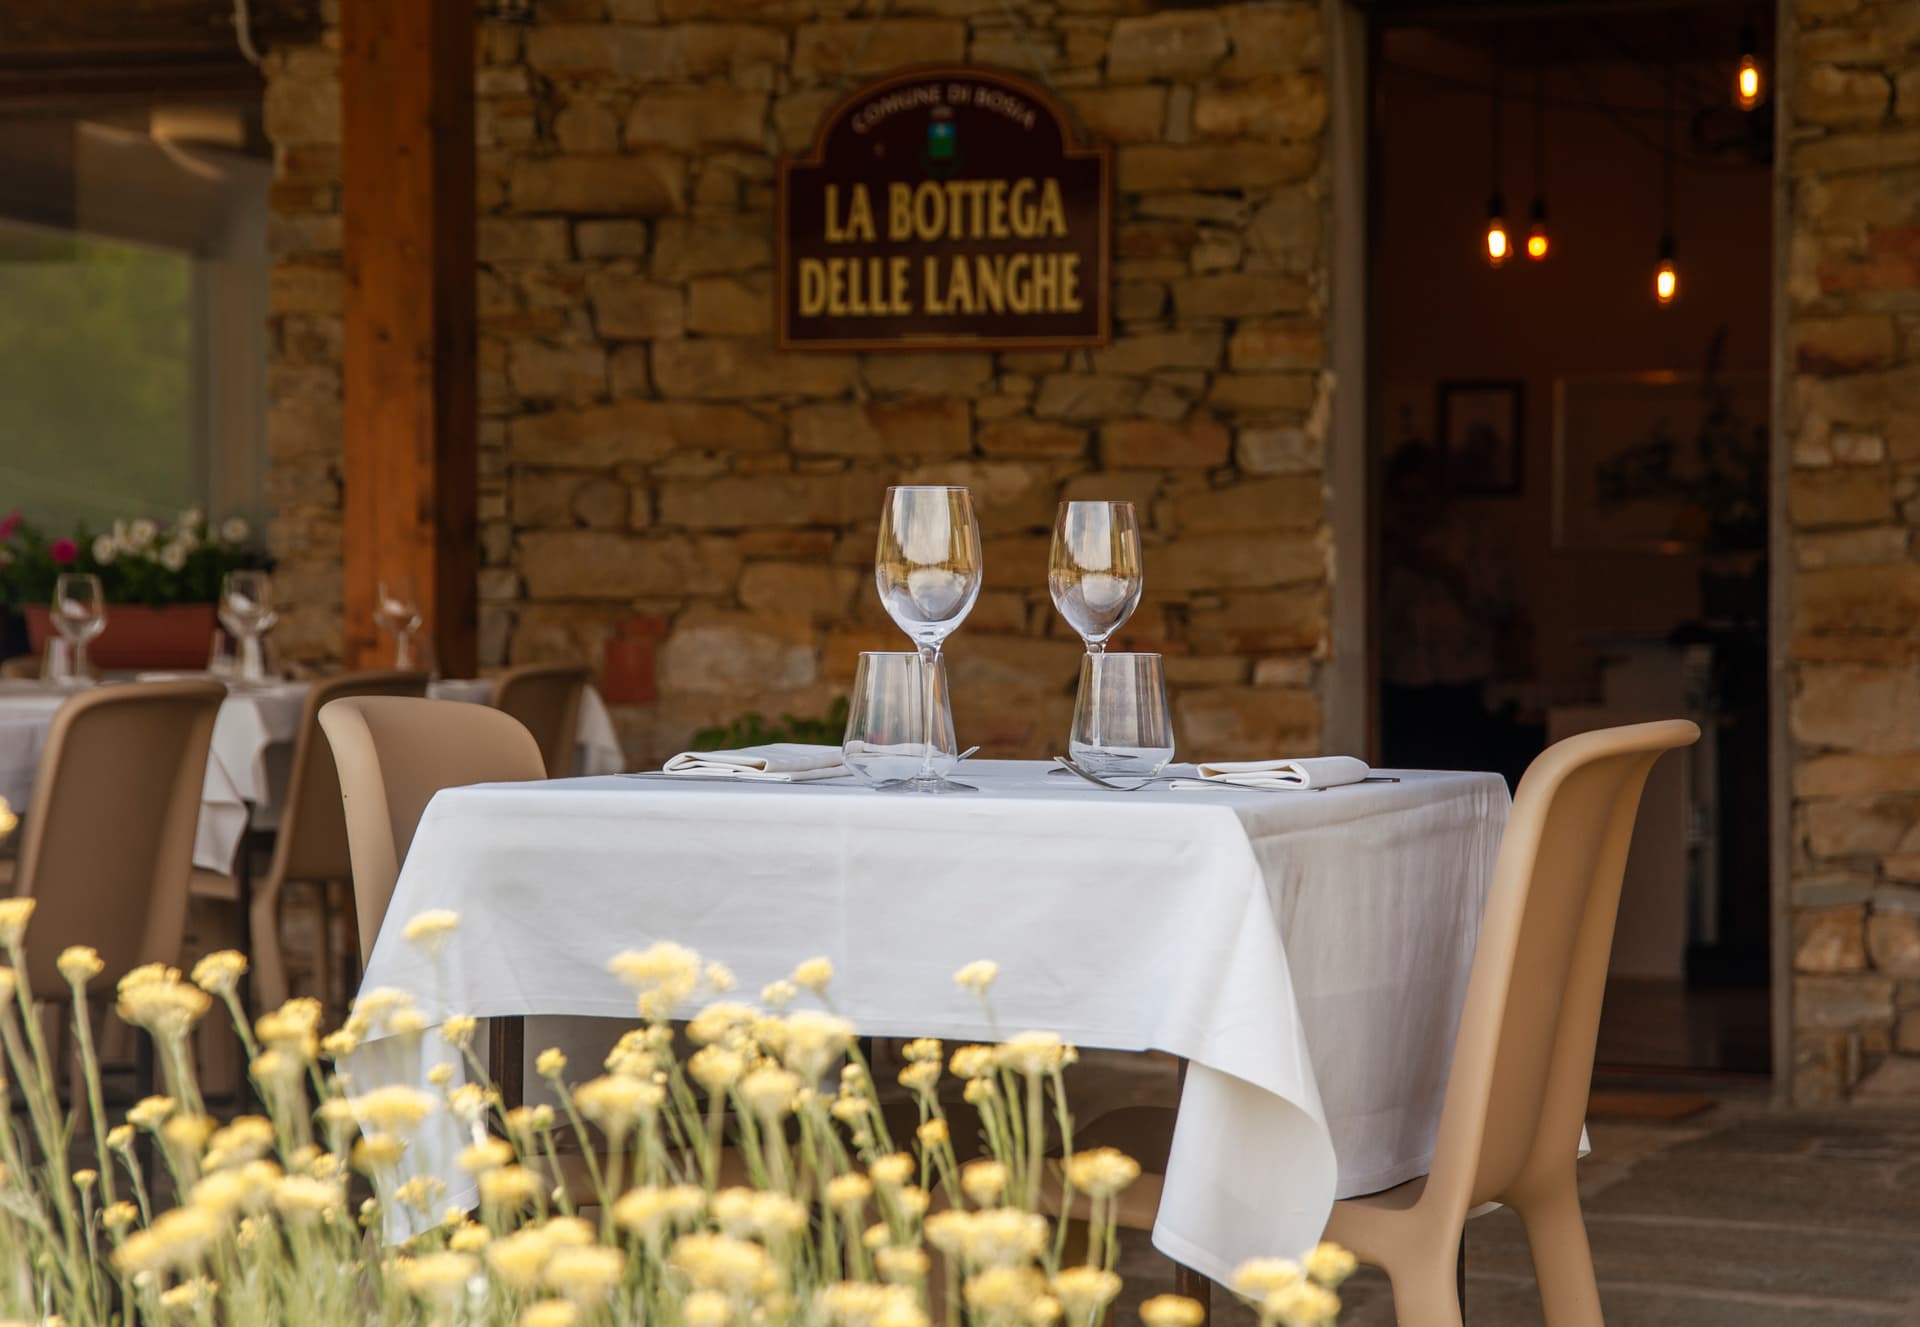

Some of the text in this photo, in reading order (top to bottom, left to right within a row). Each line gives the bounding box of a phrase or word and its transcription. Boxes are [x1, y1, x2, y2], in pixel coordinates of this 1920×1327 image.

[852, 84, 940, 134] COMUNE
[947, 84, 971, 105] DI
[824, 177, 1067, 243] LA BOTTEGA
[798, 253, 1083, 317] DELLE LANGHE
